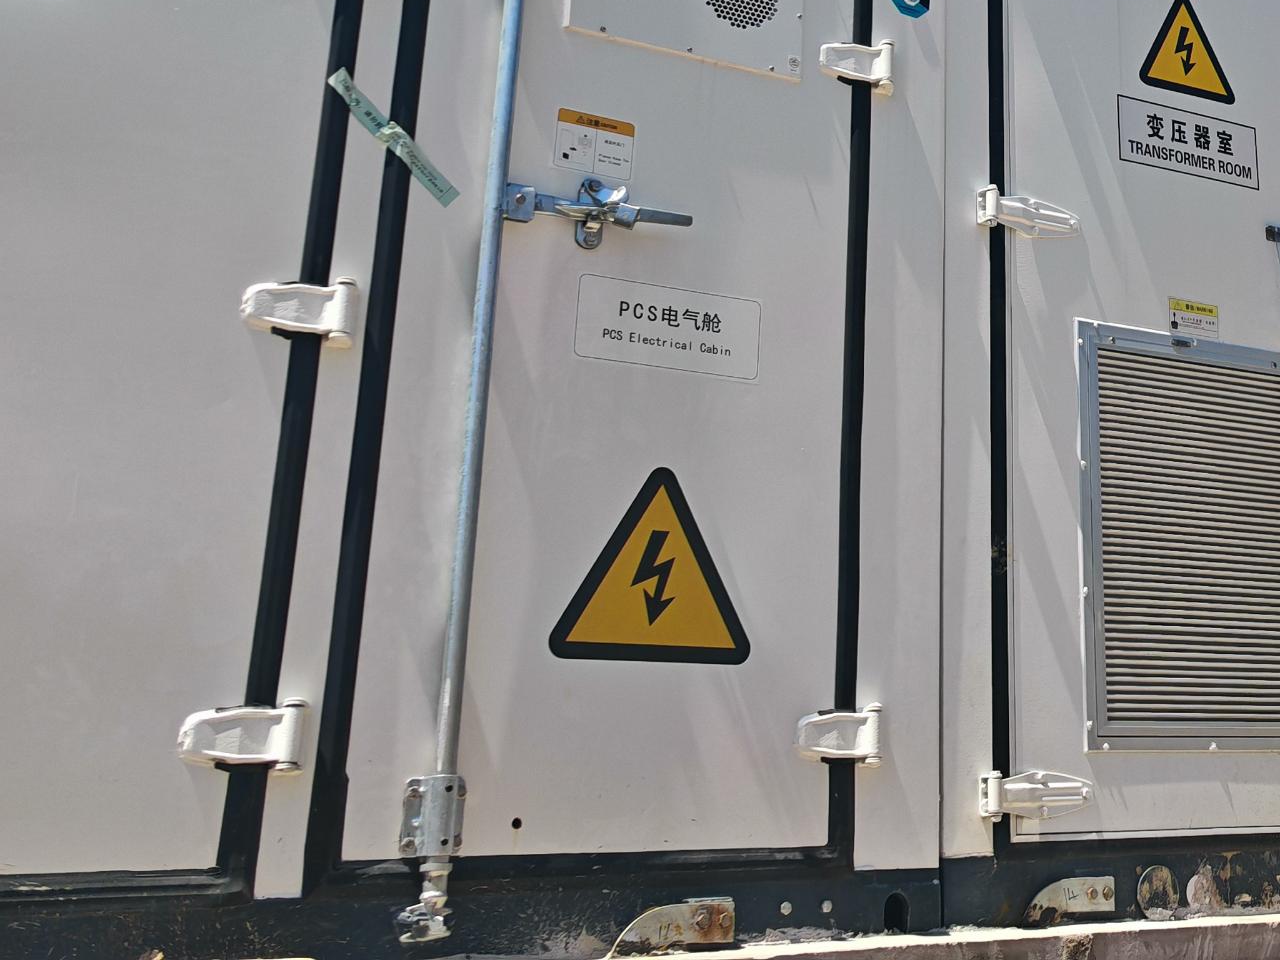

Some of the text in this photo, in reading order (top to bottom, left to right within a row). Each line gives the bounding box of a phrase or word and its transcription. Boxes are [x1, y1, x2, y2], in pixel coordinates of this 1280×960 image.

[1146, 113, 1234, 156] 变压器室
[1127, 139, 1253, 180] TRANSFORMER ROOM
[618, 300, 722, 334] PCS电气舱
[602, 328, 732, 357] PCS Electrical Cabin
